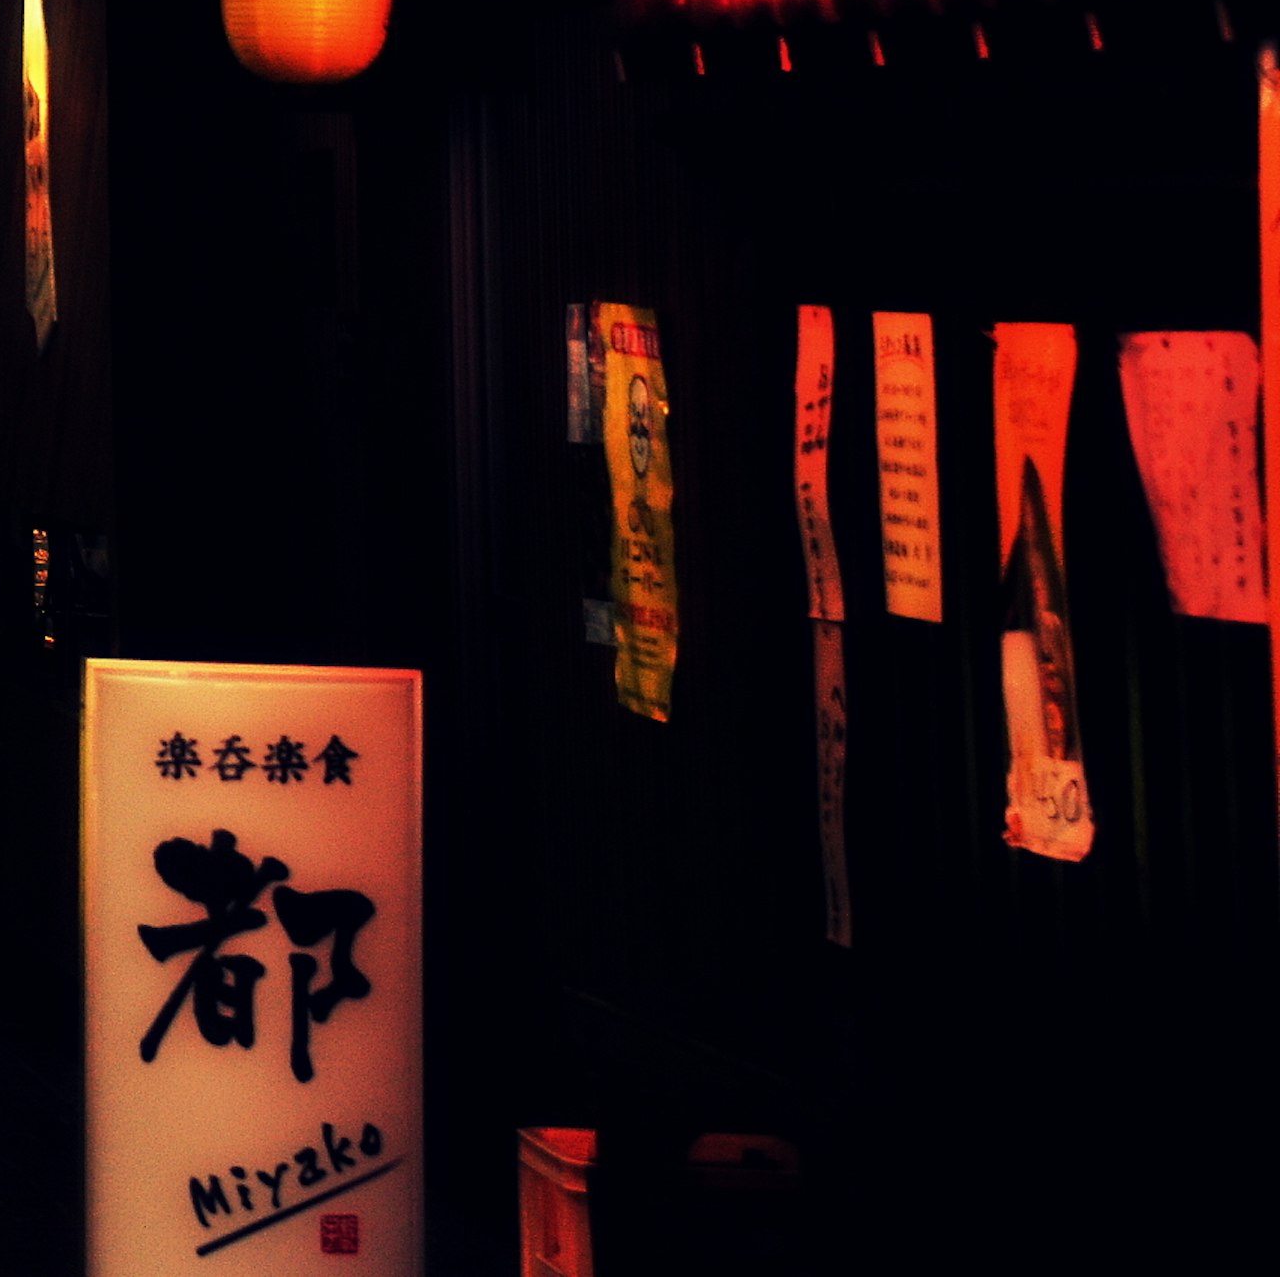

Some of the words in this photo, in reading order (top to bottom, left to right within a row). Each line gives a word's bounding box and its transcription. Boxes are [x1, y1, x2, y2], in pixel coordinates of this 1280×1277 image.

[154, 731, 360, 787] 楽呑楽食
[136, 828, 377, 1086] 都
[188, 1121, 382, 1229] Miyako
